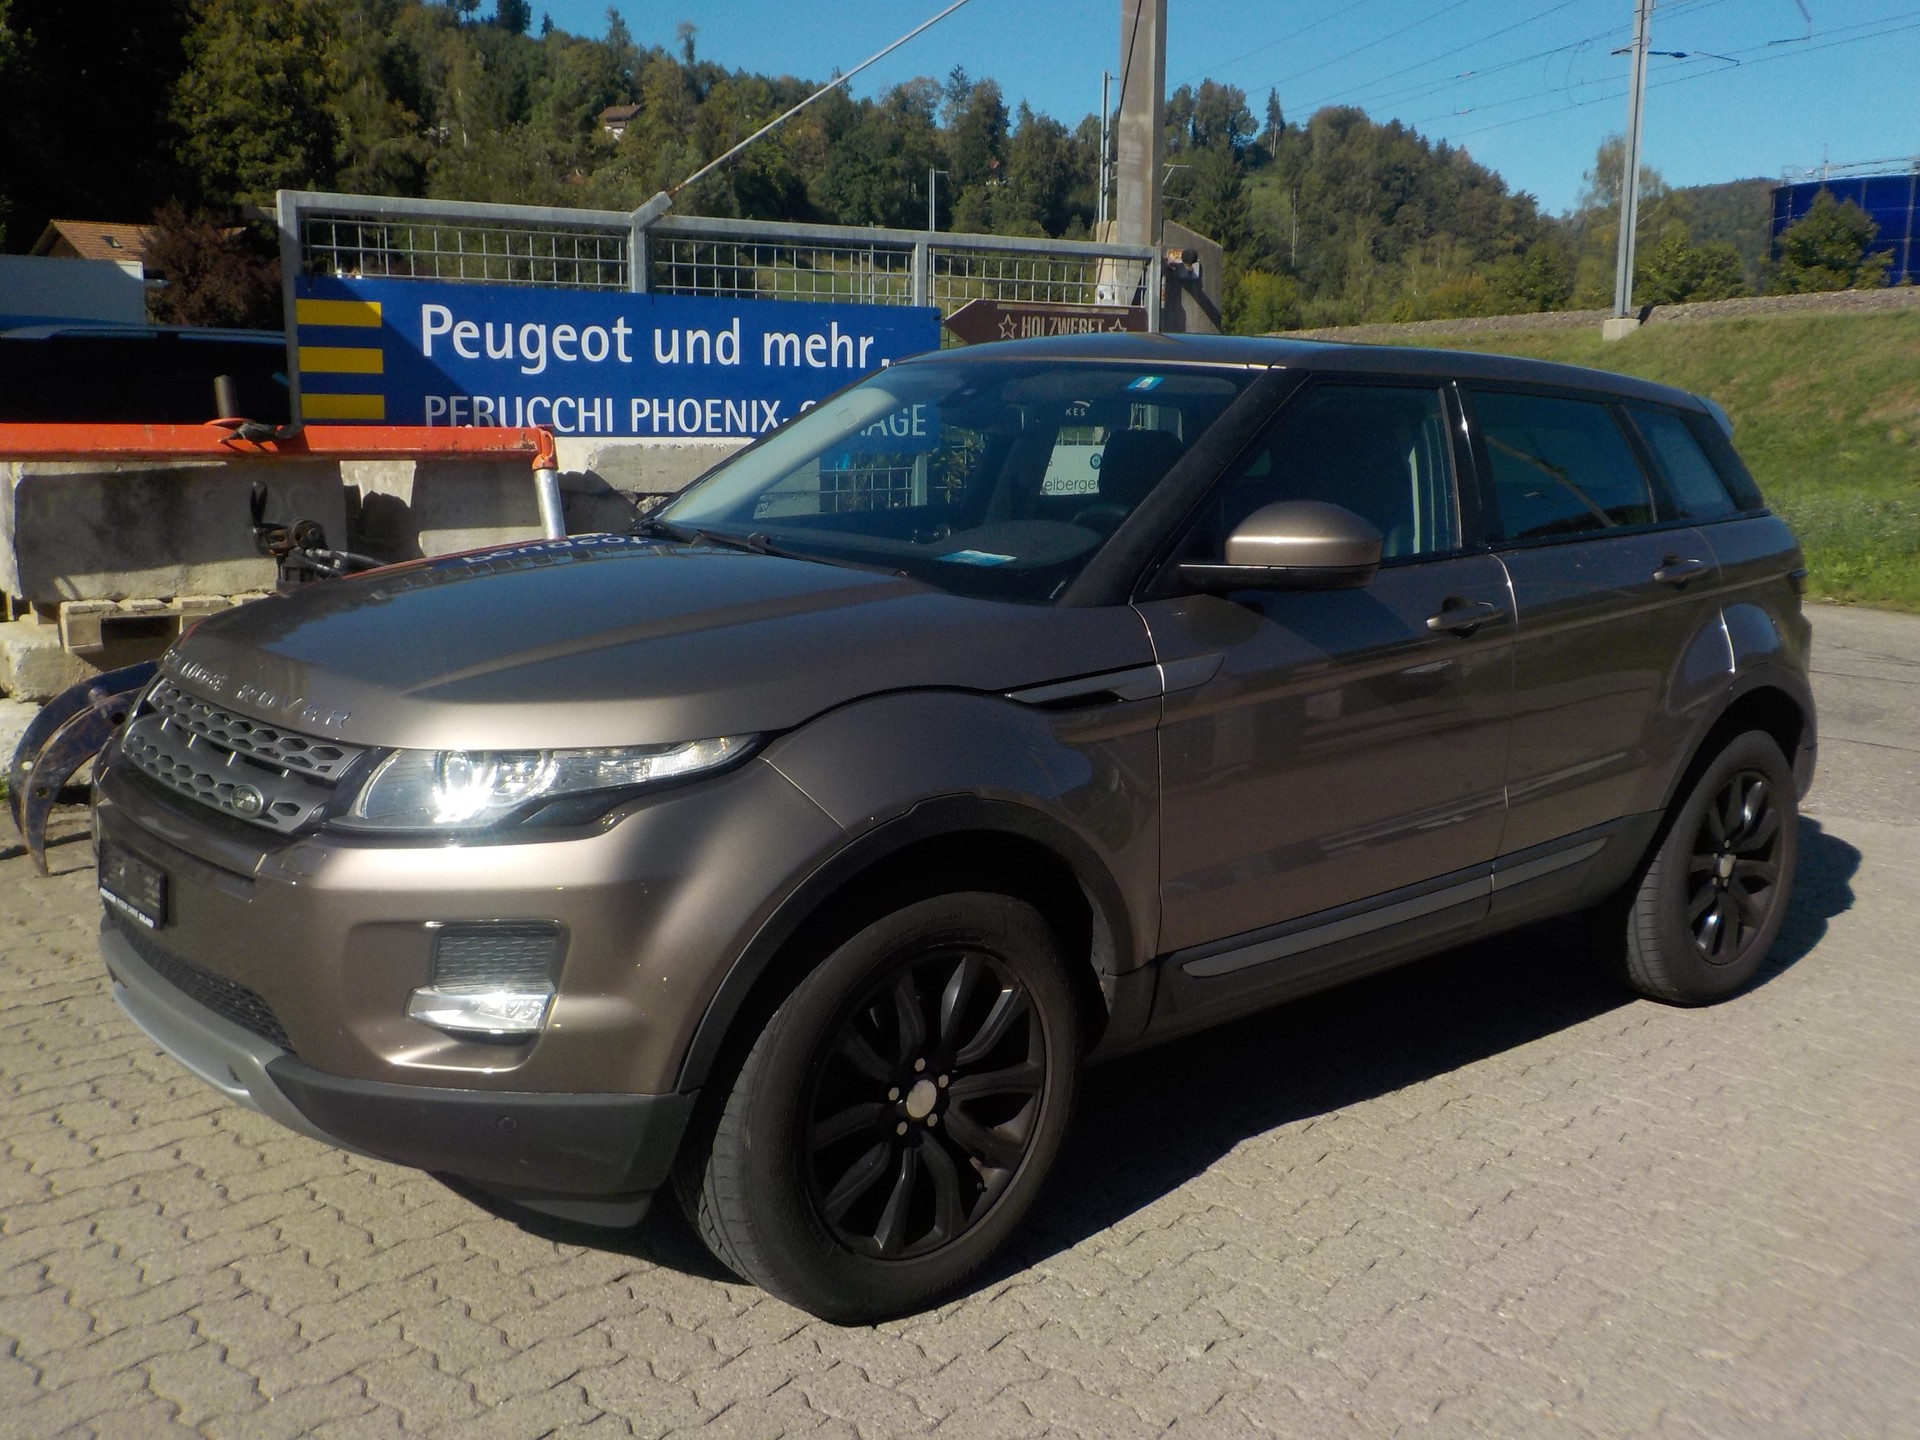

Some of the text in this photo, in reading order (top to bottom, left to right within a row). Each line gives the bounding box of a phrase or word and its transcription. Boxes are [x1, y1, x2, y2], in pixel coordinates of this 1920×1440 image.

[421, 304, 633, 374] Peugeot
[654, 317, 740, 365] und
[424, 395, 613, 433] PERUCCHI
